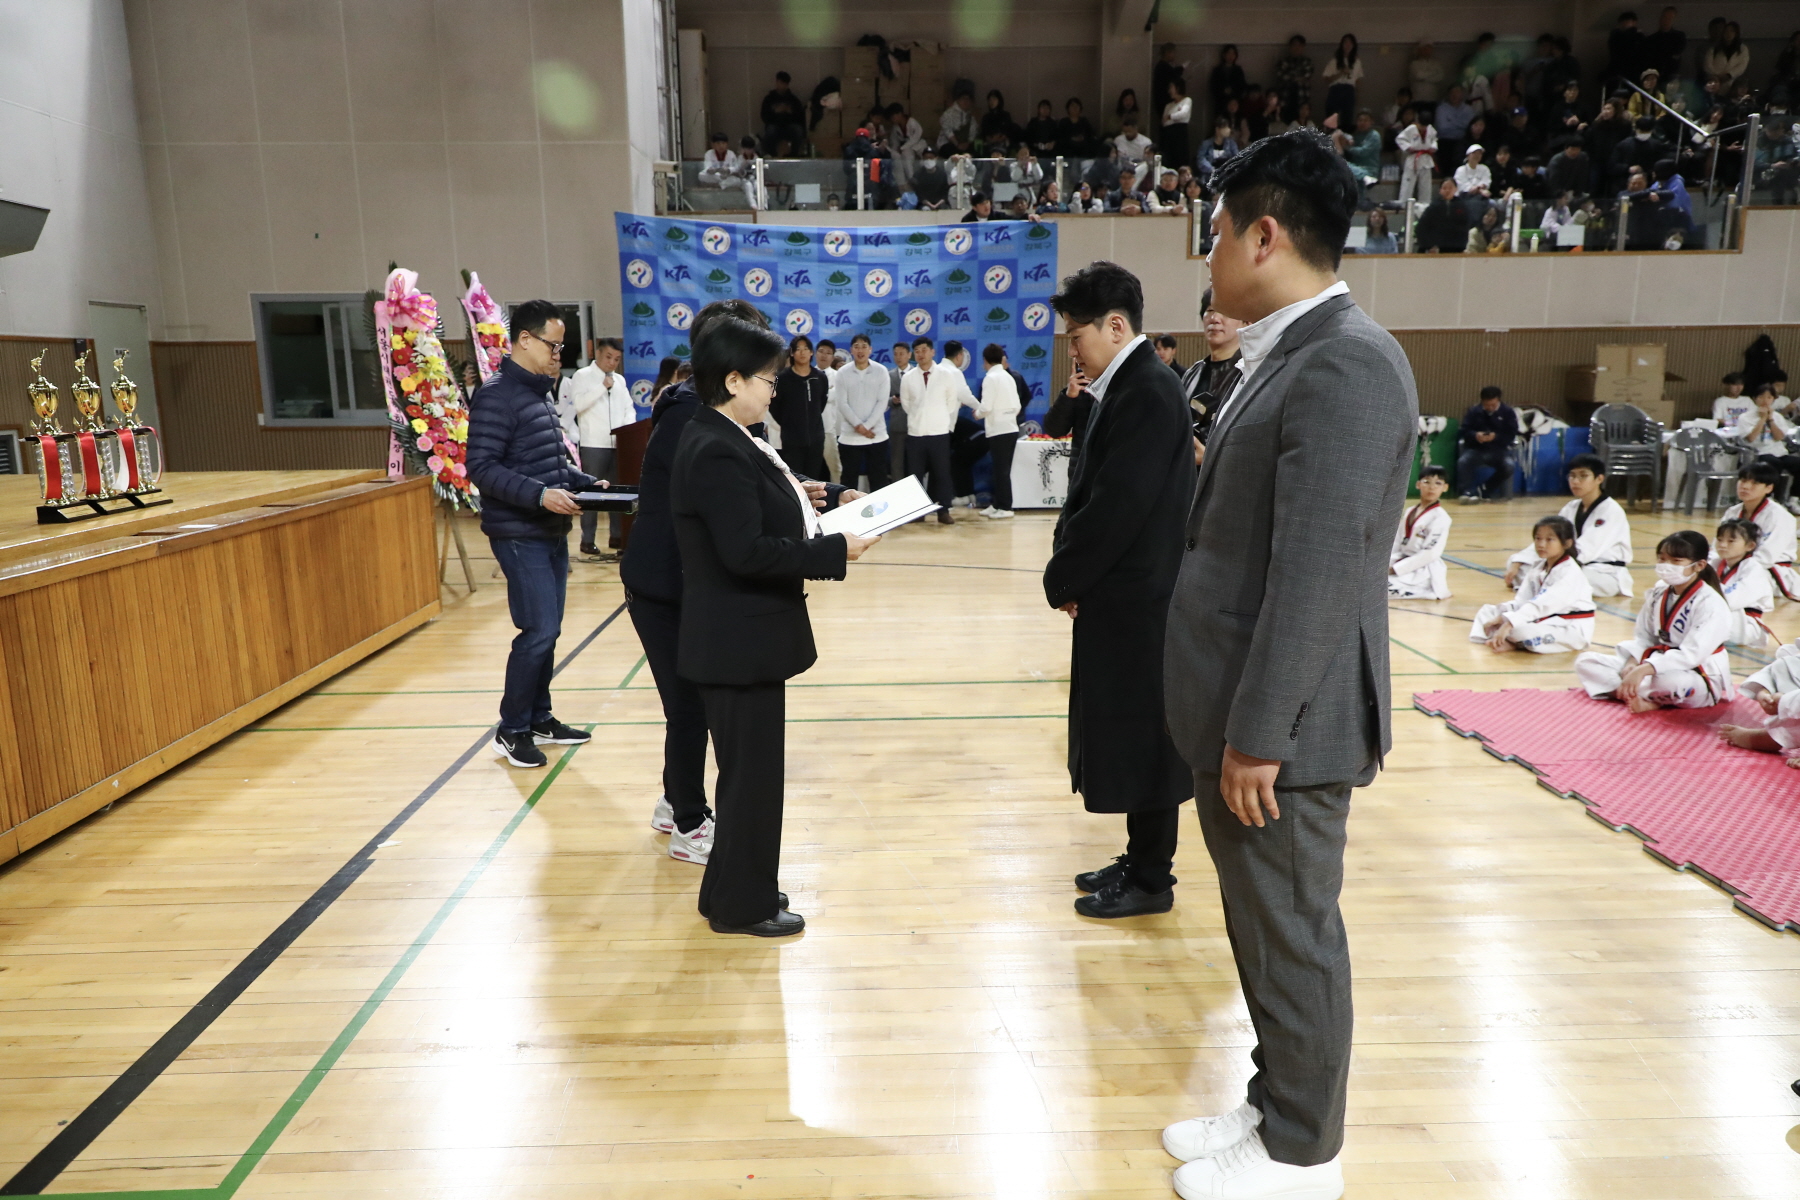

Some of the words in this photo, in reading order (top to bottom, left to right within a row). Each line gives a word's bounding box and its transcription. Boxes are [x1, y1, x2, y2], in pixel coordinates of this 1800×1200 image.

[622, 221, 649, 239] KTA
[742, 229, 770, 247] KTA
[984, 225, 1012, 244] KTA
[863, 231, 892, 248] KTA
[665, 264, 692, 282] KTA
[784, 269, 812, 287] KTA
[904, 268, 932, 288] KTA
[1024, 263, 1052, 282] KTA
[825, 309, 852, 327] KTA
[944, 306, 971, 325] KTA
[629, 341, 656, 358] KTA
[1042, 496, 1057, 505] GTA
